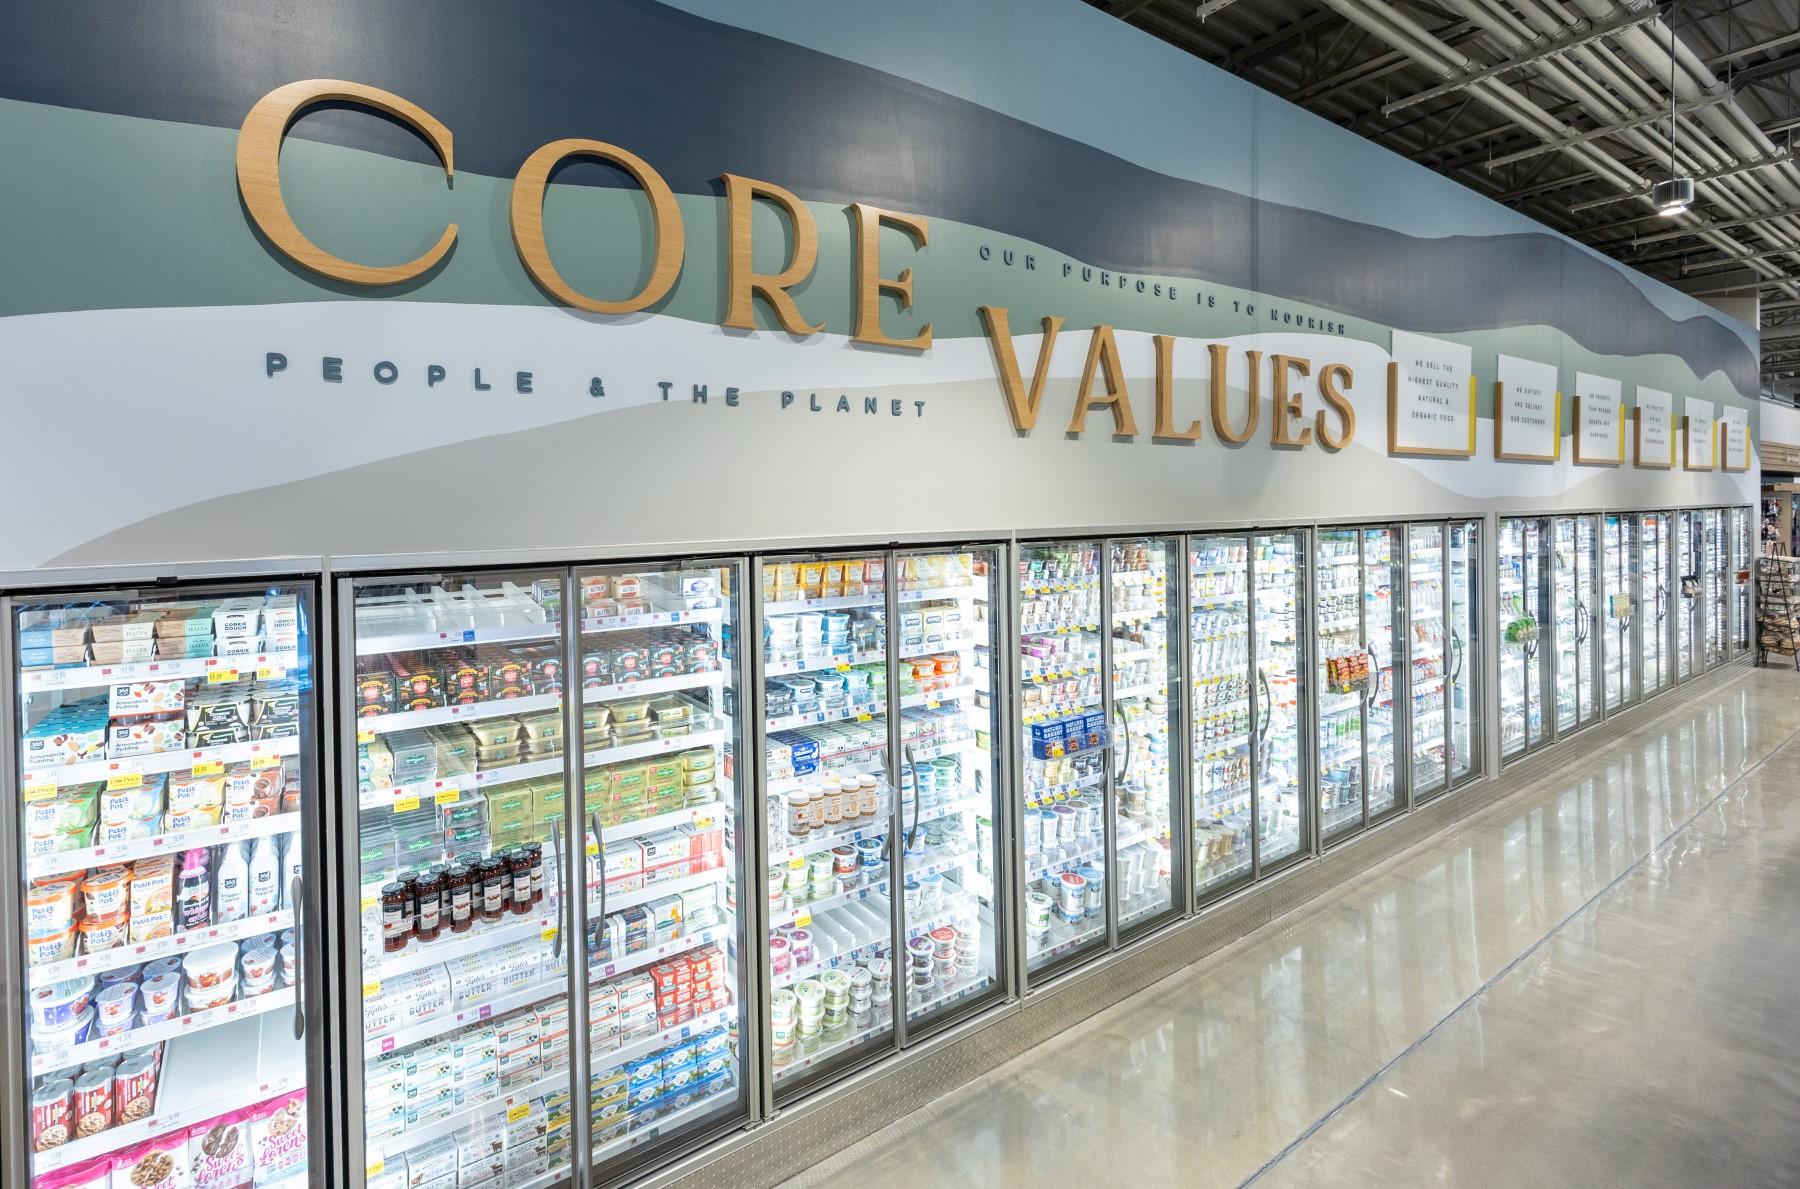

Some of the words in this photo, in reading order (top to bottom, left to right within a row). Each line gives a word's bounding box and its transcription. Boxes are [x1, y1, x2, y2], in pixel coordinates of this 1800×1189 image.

[236, 78, 933, 351] CORE
[979, 244, 1036, 270] OUR
[1062, 262, 1177, 300] PURPOSE
[1197, 291, 1216, 308] IS
[1233, 300, 1255, 317] TO
[1270, 308, 1346, 335] NOURISH
[1426, 361, 1440, 370] SELL
[1442, 364, 1452, 372] THE
[976, 304, 1357, 449] VALUES
[1408, 376, 1432, 386] HIGHEST
[1436, 380, 1458, 390] QUALITY
[265, 352, 534, 394] PEOPLE
[588, 377, 606, 398] &
[657, 381, 740, 408] THE
[780, 390, 926, 419] PLANET
[1418, 395, 1443, 404] NATURAL
[1412, 411, 1437, 420] ORGANIC
[1440, 414, 1454, 422] FOOD
[454, 809, 478, 820] Kerrygold
[455, 830, 481, 842] Kerrygold
[504, 968, 536, 984] BUTTER
[459, 983, 492, 1000] BUTTER
[409, 998, 444, 1016] BUTTER
[365, 1015, 395, 1030] UTTER
[268, 1123, 302, 1150] Sweet
[205, 1143, 242, 1172] Sweet
